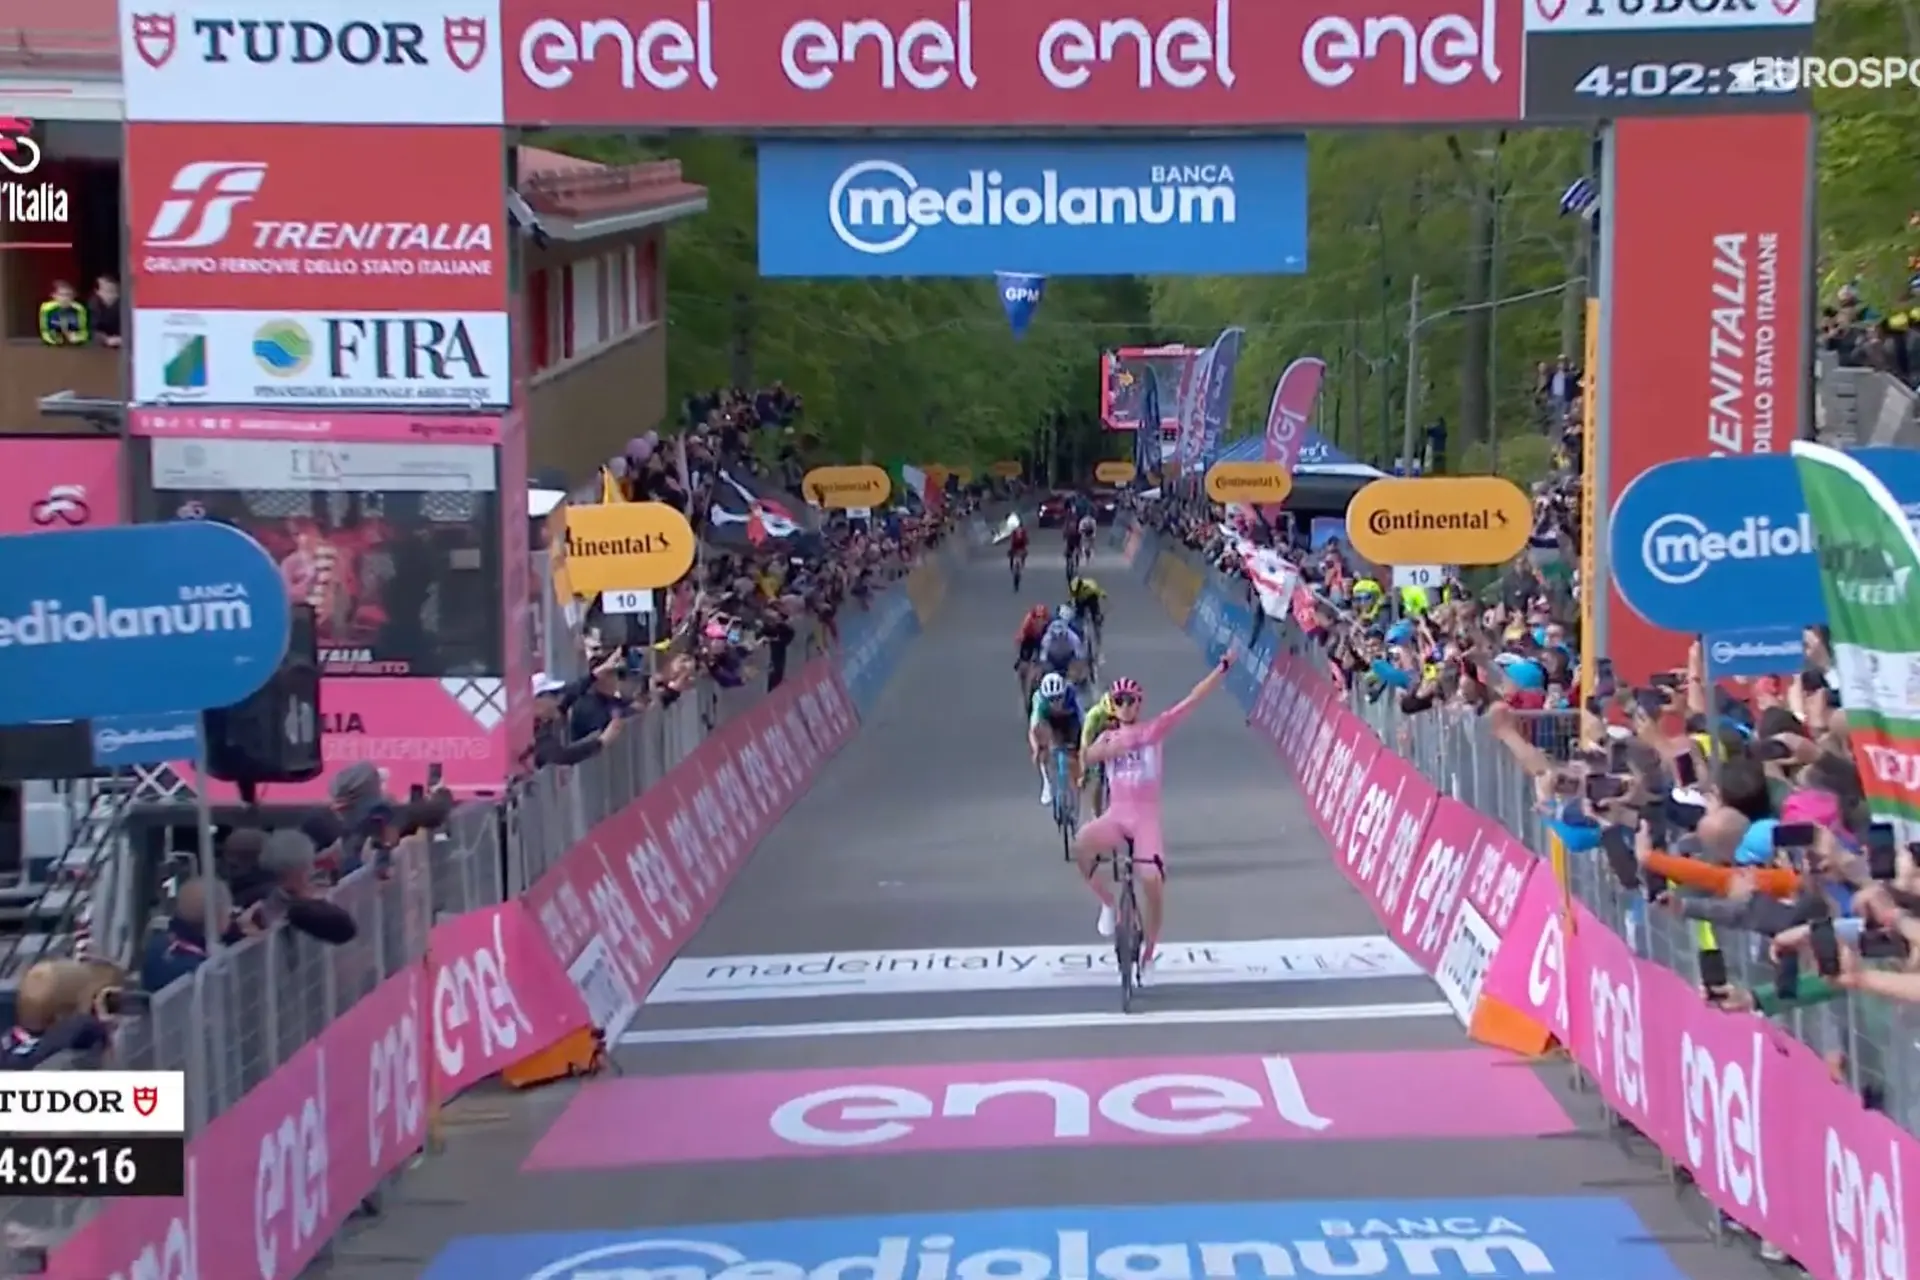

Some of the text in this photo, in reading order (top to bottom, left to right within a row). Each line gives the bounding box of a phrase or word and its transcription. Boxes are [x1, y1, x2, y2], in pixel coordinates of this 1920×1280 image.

[194, 19, 428, 66] TUDOR
[520, 0, 718, 90] enel
[781, 0, 978, 90] enel
[1038, 0, 1235, 90] enel
[1301, 0, 1503, 86] enel
[846, 168, 1236, 226] mediolanum
[1151, 164, 1235, 184] BANCA
[143, 256, 217, 273] GRUPPO
[304, 259, 357, 275] DELLO
[362, 259, 414, 275] STATO
[417, 260, 492, 276] ITALIANE
[252, 221, 492, 251] TRENITALIA
[1005, 287, 1039, 303] GPM
[1756, 232, 1779, 321] ITALIANE
[321, 318, 490, 380] FIRA
[1754, 326, 1776, 388] STATO
[1369, 508, 1489, 536] Continental
[178, 583, 248, 600] BANCA
[616, 593, 636, 607] 10
[1409, 569, 1429, 584] 10
[434, 913, 533, 1076] enel
[770, 1056, 1333, 1146] enel
[1681, 1031, 1767, 1217] enel
[255, 1048, 328, 1280] enel
[1320, 1216, 1528, 1237] BANCA
[1826, 1126, 1908, 1280] enel
